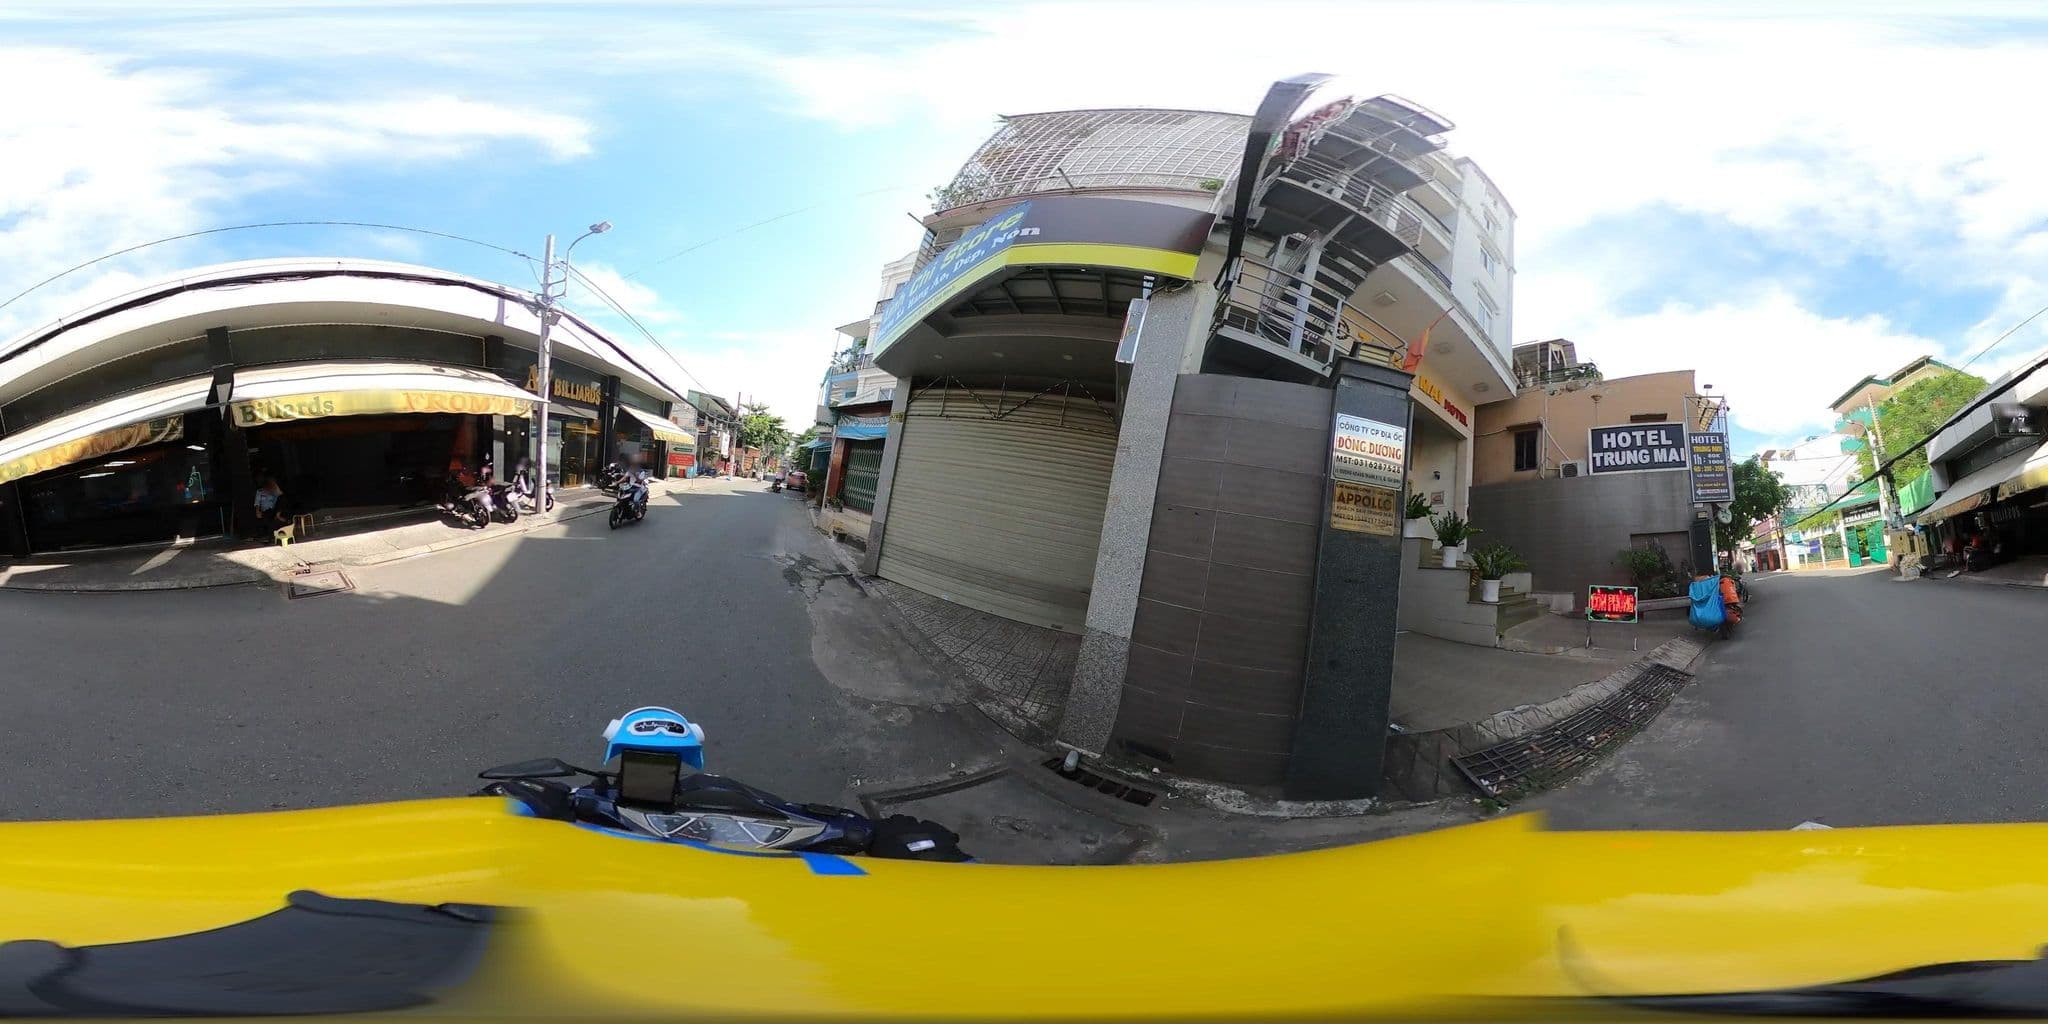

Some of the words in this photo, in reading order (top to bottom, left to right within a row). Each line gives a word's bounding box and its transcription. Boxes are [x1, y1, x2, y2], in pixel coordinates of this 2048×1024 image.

[553, 378, 601, 405] BILLIARDS
[1602, 429, 1673, 449] HOTEL
[1691, 435, 1723, 444] HOTEL
[1592, 449, 1650, 467] TRUNG
[1653, 447, 1686, 463] MAI
[1336, 491, 1392, 511] APPOLLO
